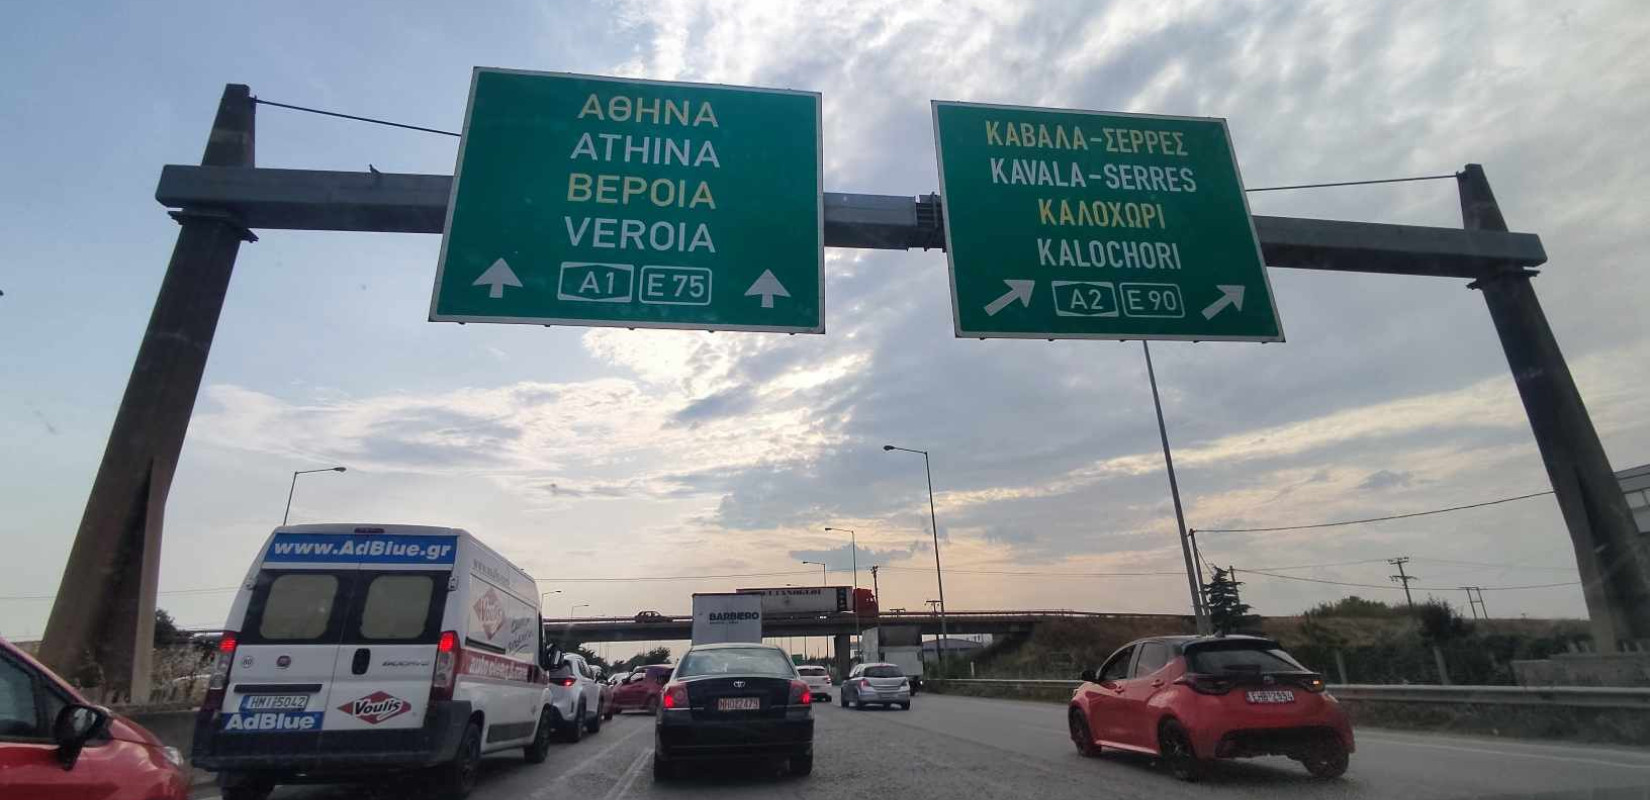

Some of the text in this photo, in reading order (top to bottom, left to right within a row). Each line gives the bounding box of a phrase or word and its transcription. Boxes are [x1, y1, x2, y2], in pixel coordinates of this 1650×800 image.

[577, 93, 719, 128] ΑΘΗΝΑ
[570, 132, 720, 168] ATHINA
[567, 172, 716, 209] ΒΕΡΟΙΑ
[1038, 198, 1166, 230] ΚΑΛΟΧΩΡΙ
[564, 216, 716, 253] VEROIA
[1037, 238, 1182, 270] KALOCHORI
[578, 271, 614, 295] A1
[1070, 289, 1104, 311] A2
[274, 539, 452, 560] www.AdBlue.gr
[709, 611, 759, 621] BARBIERO
[226, 712, 315, 731] AdBlue
[355, 700, 402, 715] Voulis
